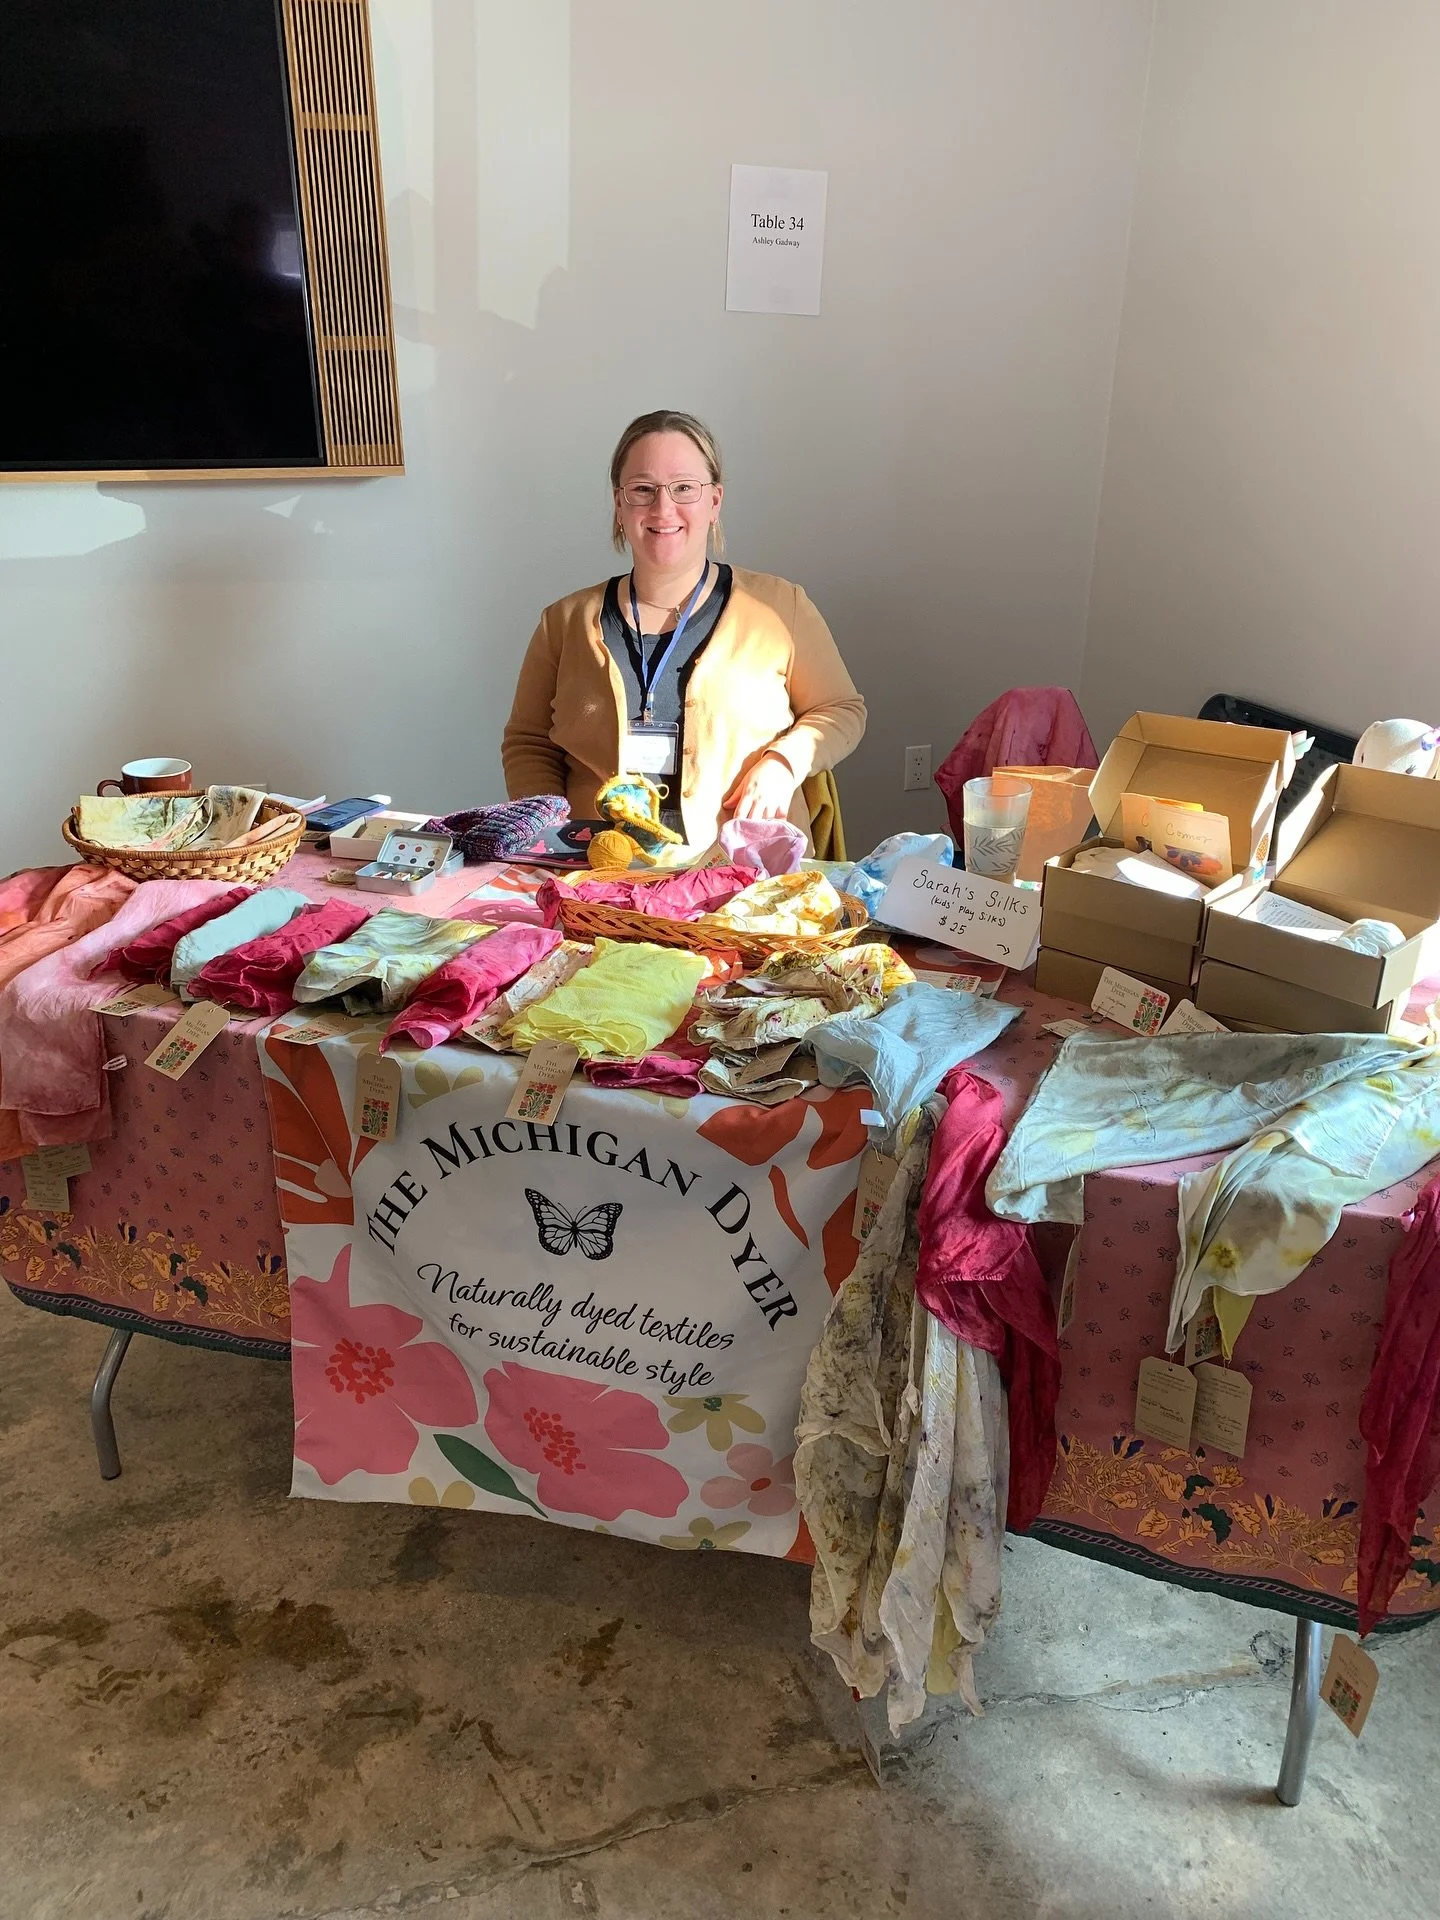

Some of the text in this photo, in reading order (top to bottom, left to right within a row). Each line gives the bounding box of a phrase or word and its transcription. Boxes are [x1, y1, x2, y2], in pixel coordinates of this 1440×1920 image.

[751, 213, 804, 231] Table 34
[752, 236, 800, 249] Ashley Gadway
[913, 869, 1029, 915] Sarah's Silks
[949, 922, 967, 935] 25
[958, 905, 975, 921] Play
[978, 911, 1006, 928] Silks)
[366, 1120, 798, 1331] THE MICHIGAN DYER
[417, 1263, 736, 1351] Naturally dyed textiles
[449, 1312, 715, 1395] for sustainable style
